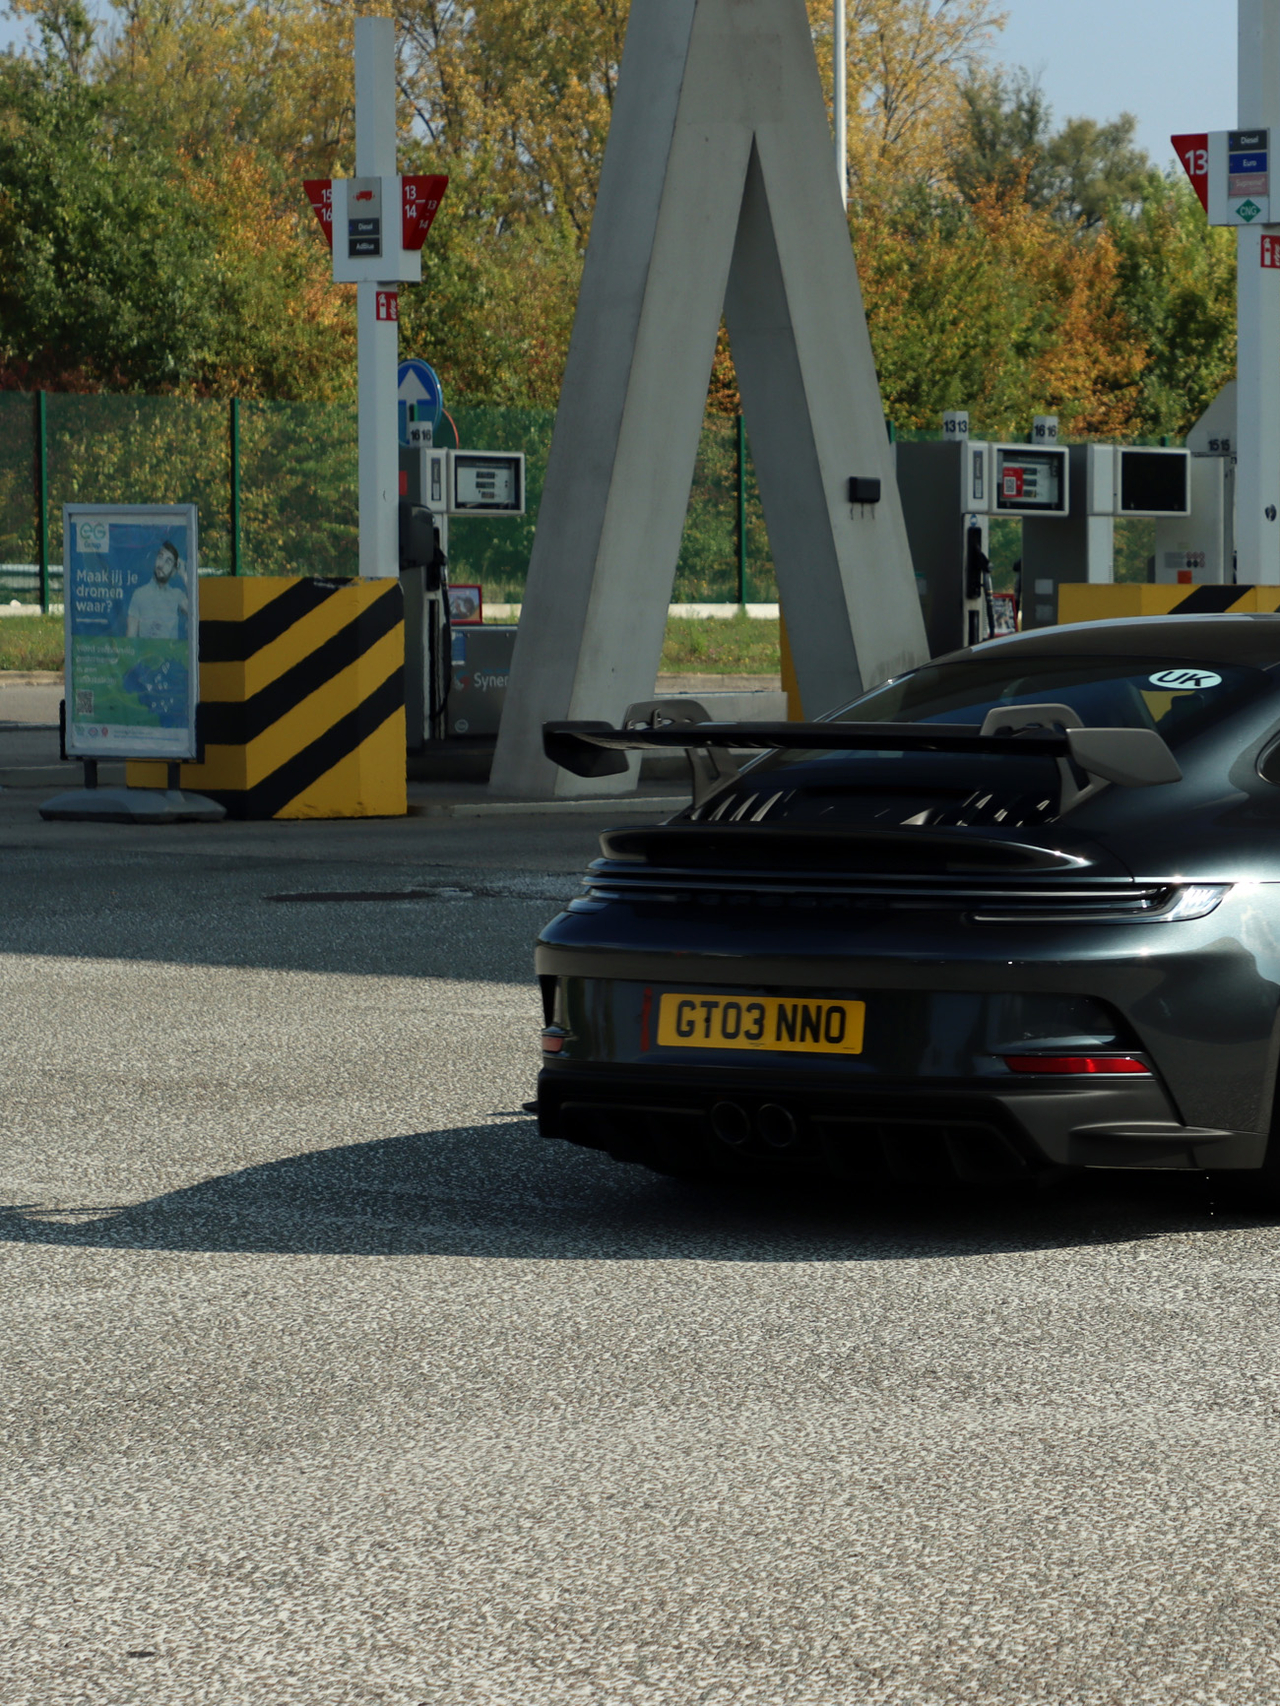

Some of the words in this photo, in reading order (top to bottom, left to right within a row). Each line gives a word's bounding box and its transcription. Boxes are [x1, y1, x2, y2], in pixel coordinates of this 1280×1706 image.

[1240, 135, 1259, 144] Diesel
[1185, 149, 1208, 175] 13
[1243, 159, 1257, 167] Euro
[404, 185, 417, 200] 13
[321, 207, 332, 221] 16
[404, 204, 417, 219] 14
[1239, 205, 1258, 216] CNG
[943, 420, 956, 433] 13
[957, 420, 968, 433] 13
[1034, 424, 1046, 437] 16
[1047, 424, 1057, 437] 16
[411, 428, 420, 441] 16
[421, 428, 431, 441] 16
[1208, 438, 1220, 451] 15
[76, 569, 108, 583] Maak
[111, 569, 123, 586] jij
[127, 570, 139, 586] je
[76, 584, 124, 599] dromen
[75, 600, 113, 614] waar?
[474, 672, 510, 692] Syner
[1157, 671, 1216, 687] UK
[675, 1000, 766, 1041] GT03
[775, 1003, 847, 1044] NNO
